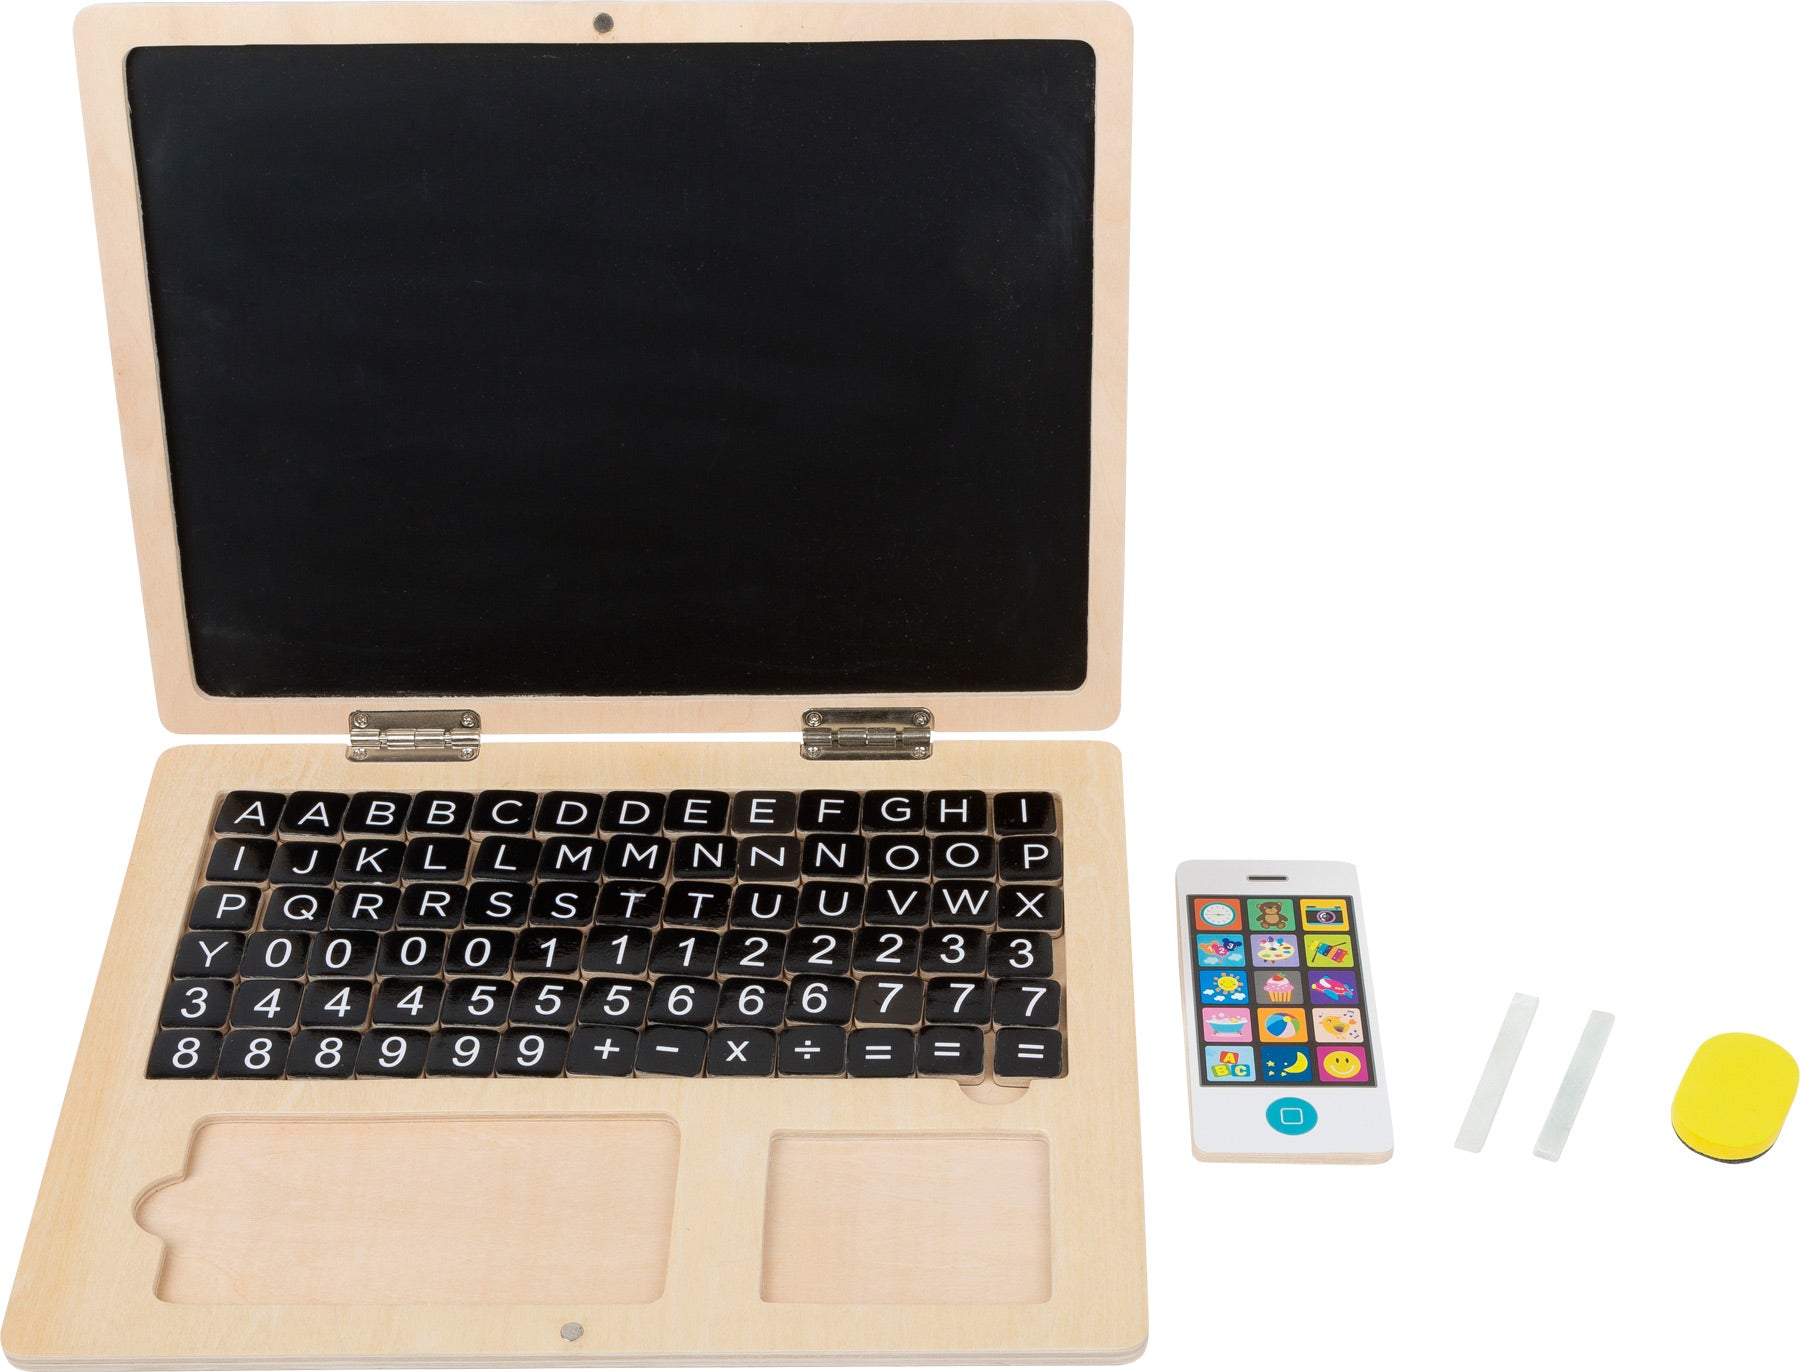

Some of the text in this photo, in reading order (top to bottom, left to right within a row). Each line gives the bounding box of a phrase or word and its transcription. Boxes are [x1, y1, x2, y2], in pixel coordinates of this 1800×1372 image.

[233, 797, 1028, 827] A A B B C D D E E F G H I
[233, 842, 1049, 874] I J K L L M M N N N O O P
[216, 888, 1045, 921] P Q R R S S T T U U V W X
[198, 940, 229, 968] Y
[540, 937, 557, 968] 1
[611, 934, 629, 965] 1
[679, 937, 696, 967] 1
[739, 937, 769, 967] 2
[807, 934, 836, 965] 2
[875, 933, 903, 963] 2
[940, 933, 965, 964] 3
[1009, 938, 1034, 969] 3
[180, 982, 1047, 1019] 3 4 4 4 5 5 5 6 6 6 7 7 7
[172, 1037, 201, 1069] 8
[244, 1037, 273, 1070] 8
[314, 1037, 343, 1069] 8
[378, 1036, 407, 1068] 9
[452, 1035, 481, 1067] 9
[516, 1034, 545, 1067] 9
[593, 1038, 620, 1060] +
[865, 1045, 892, 1060] =
[934, 1042, 961, 1057] =
[1018, 1043, 1045, 1059] =
